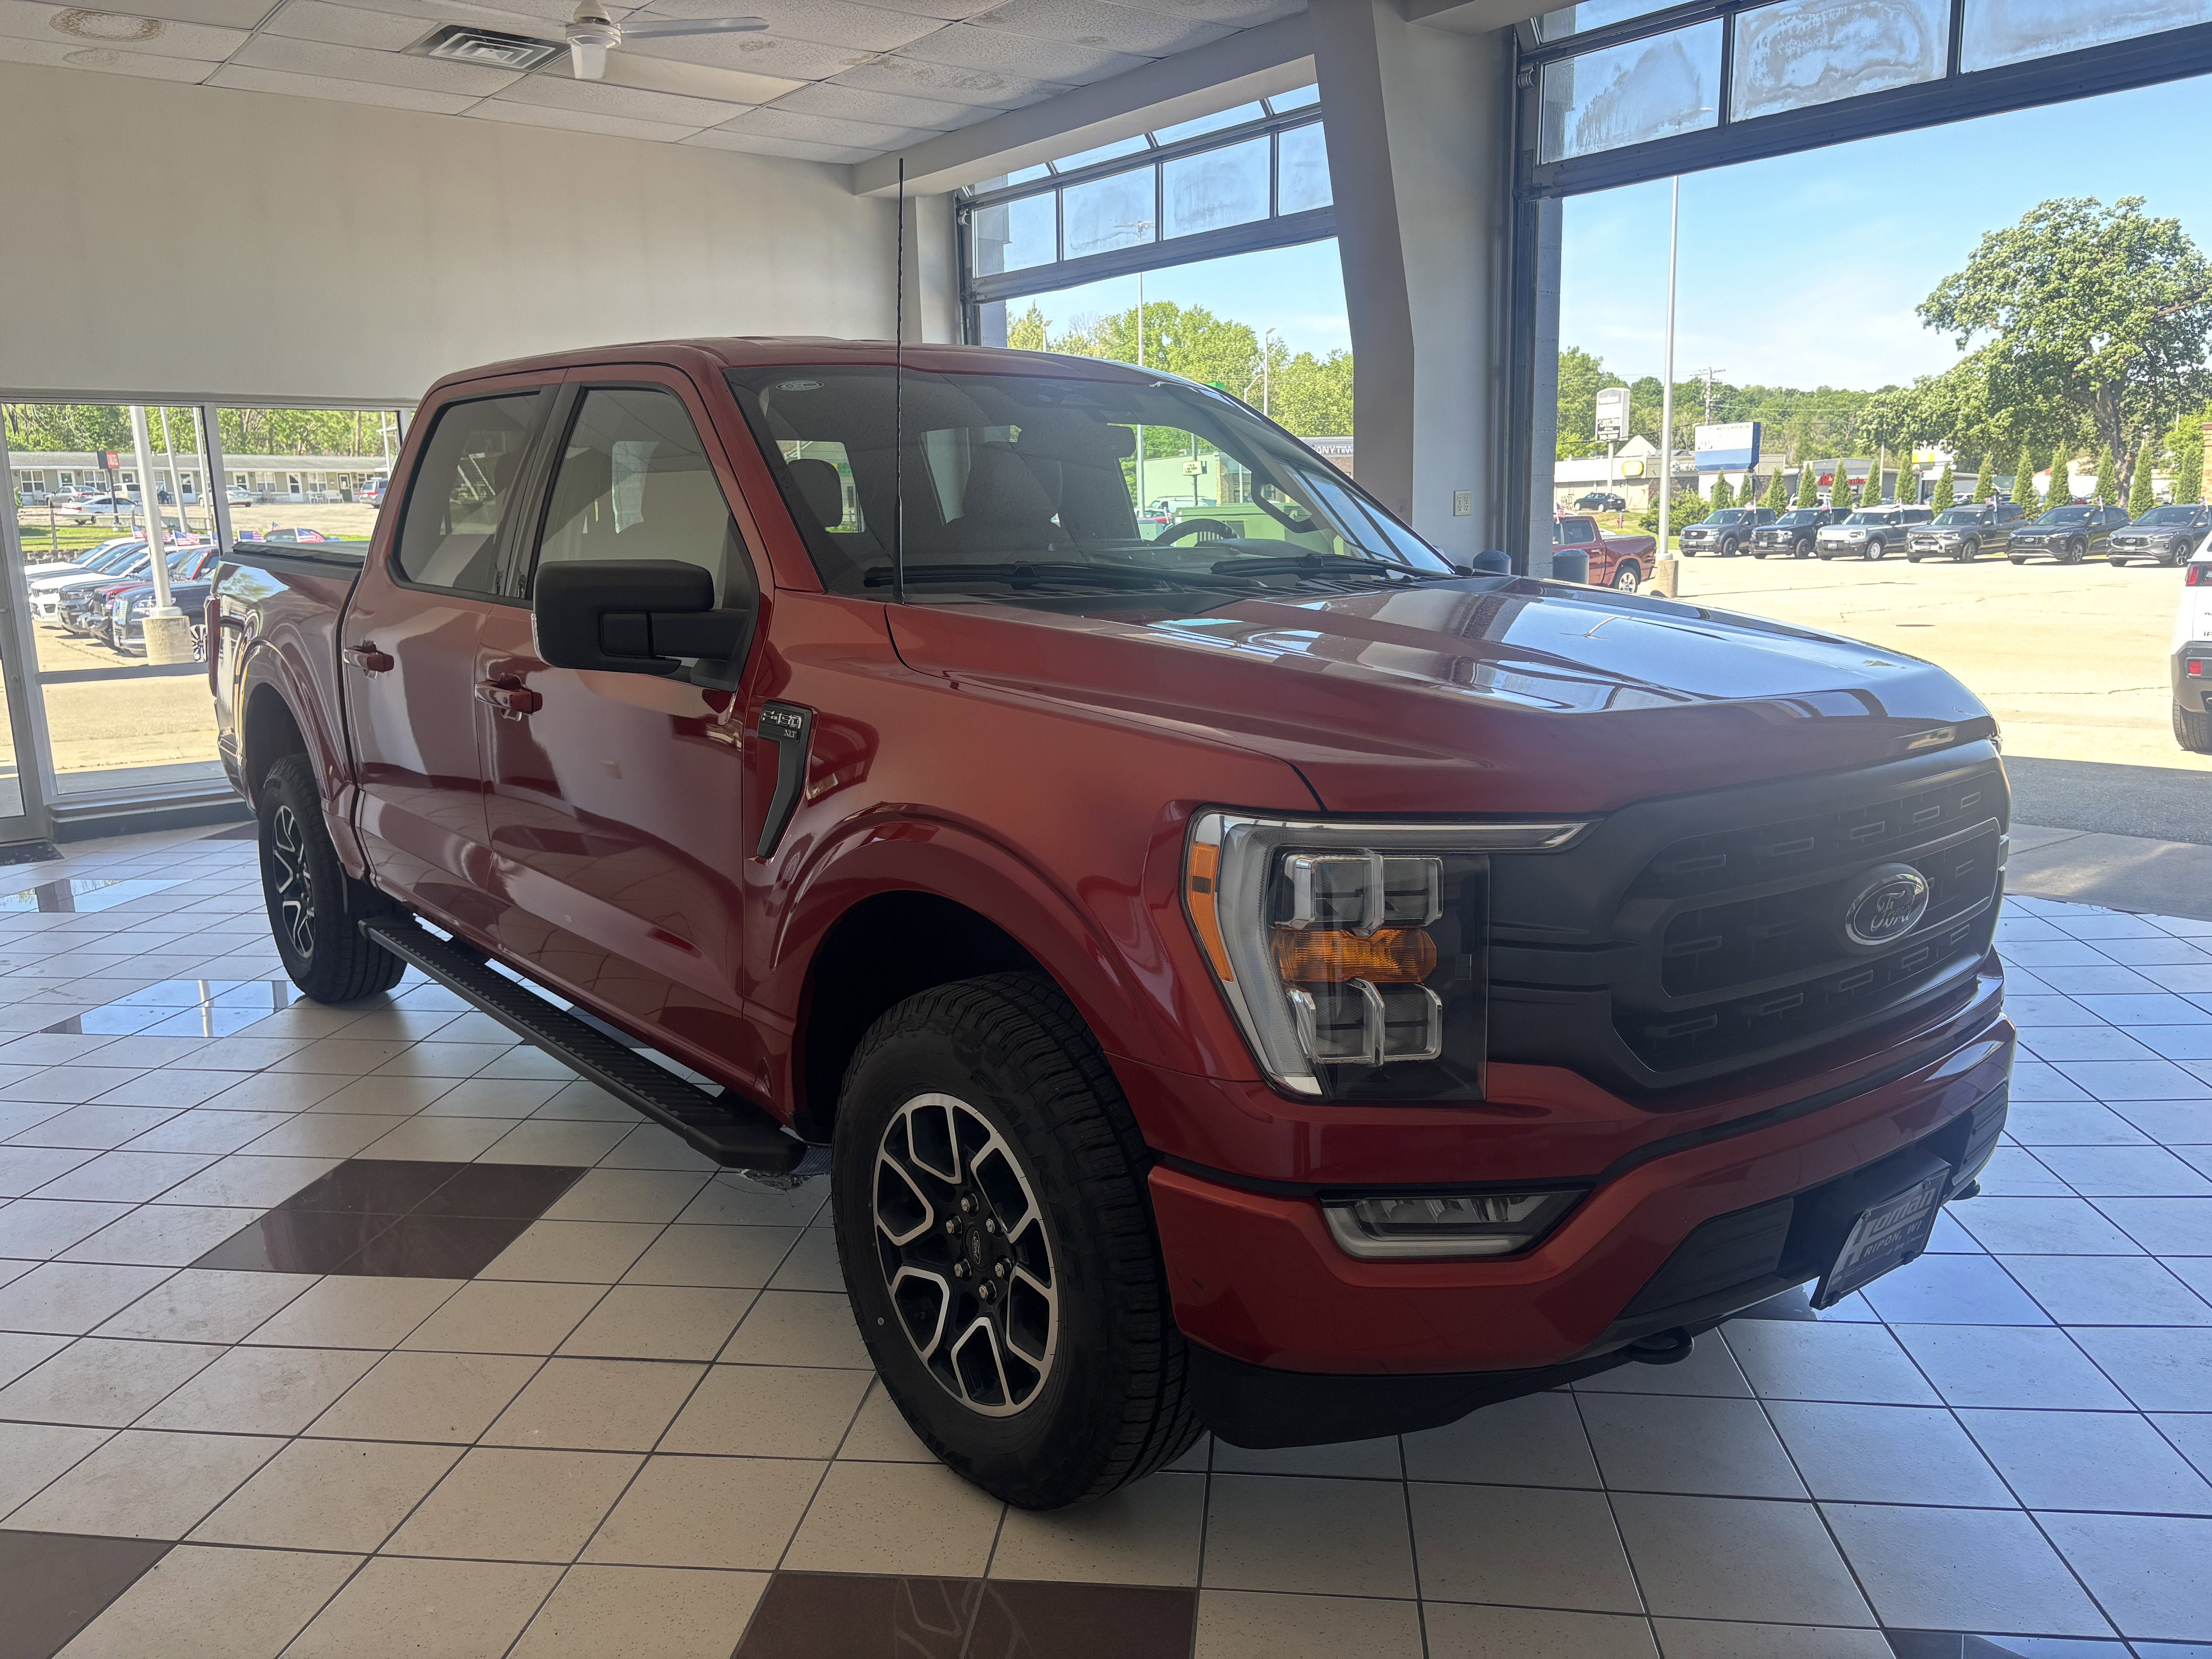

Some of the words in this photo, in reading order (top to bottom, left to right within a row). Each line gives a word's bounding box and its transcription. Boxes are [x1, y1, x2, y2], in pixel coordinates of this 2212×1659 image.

[761, 710, 802, 729] F-150
[784, 729, 797, 738] XLT
[1870, 890, 1915, 933] Ford
[1833, 1188, 1936, 1277] Homan
[1863, 1230, 1902, 1258] RIPON,
[1906, 1220, 1923, 1235] WI
